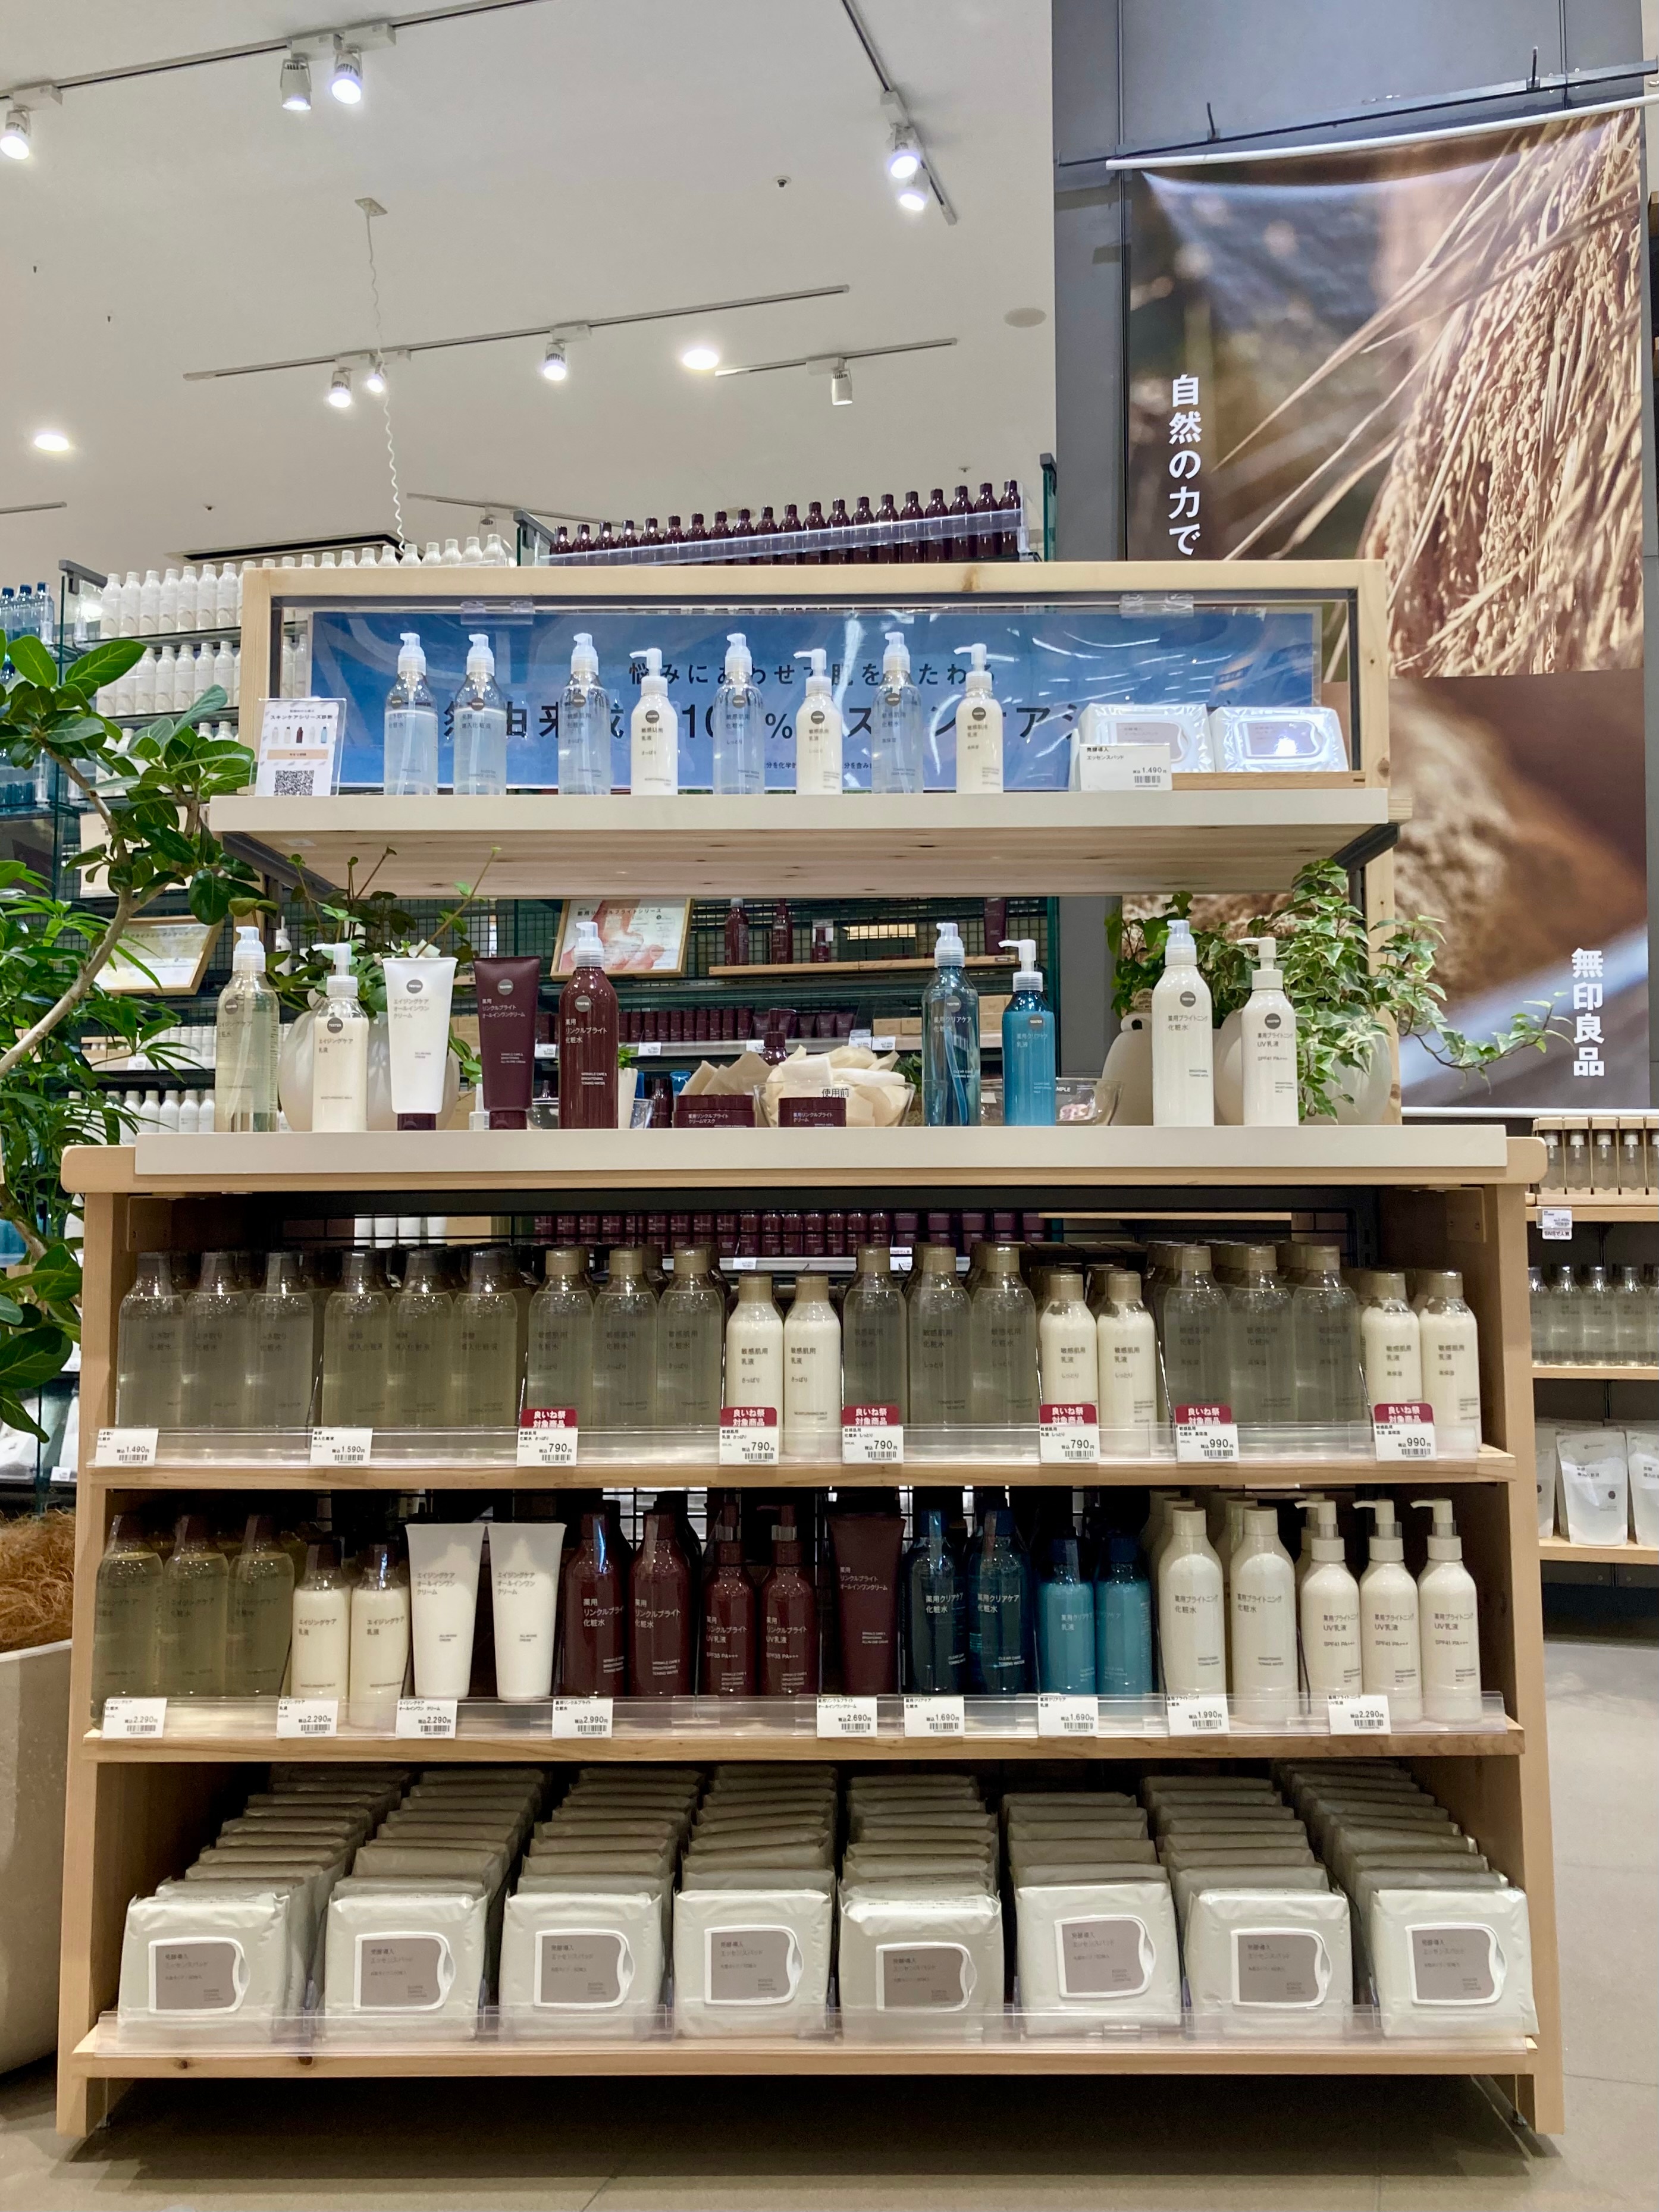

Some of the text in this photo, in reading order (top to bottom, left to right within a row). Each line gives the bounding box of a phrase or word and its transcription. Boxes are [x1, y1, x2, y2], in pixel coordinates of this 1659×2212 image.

[1168, 374, 1202, 556] 自然の力で
[1571, 947, 1605, 1076] 無印良品
[566, 1027, 607, 1035] リンクルブライト
[534, 1410, 566, 1419] 良いね祭
[733, 1408, 765, 1417] 良いね祭
[855, 1408, 887, 1417] 良いね祭
[1052, 1407, 1084, 1416] 良いね祭
[1188, 1407, 1220, 1416] 良いね祭
[1388, 1406, 1420, 1415] 良いね祭
[977, 1593, 1020, 1604] 薬用クリアケア
[1175, 1595, 1218, 1604] 薬用ブライトニング
[1237, 1593, 1282, 1604] 薬用ブライトニング
[635, 1608, 680, 1618] リンクルブライト
[926, 1605, 948, 1614] 化粧水
[977, 1605, 998, 1614] 化粧水
[1175, 1605, 1197, 1614] 化粧水
[1237, 1604, 1257, 1614] 化粧水
[583, 1618, 606, 1627] 化粧水
